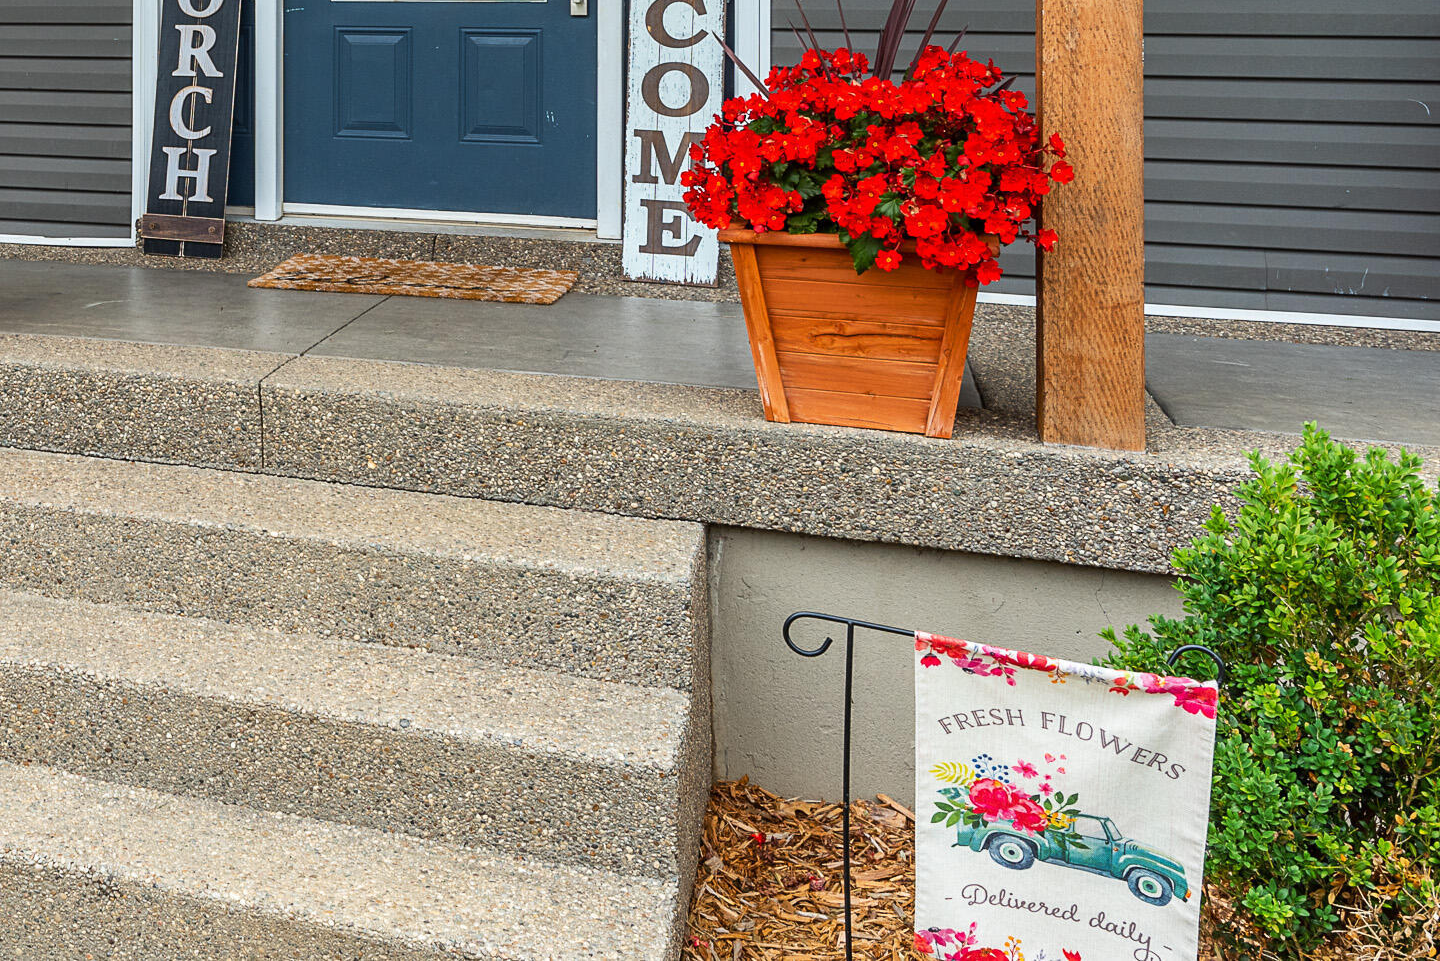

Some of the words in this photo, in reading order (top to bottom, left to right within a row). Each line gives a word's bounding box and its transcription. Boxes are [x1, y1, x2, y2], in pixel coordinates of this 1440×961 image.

[938, 708, 1025, 735] FRESH
[1041, 711, 1186, 780] FLOWERS
[961, 883, 1080, 922] Delivered
[1089, 911, 1161, 961] daily
